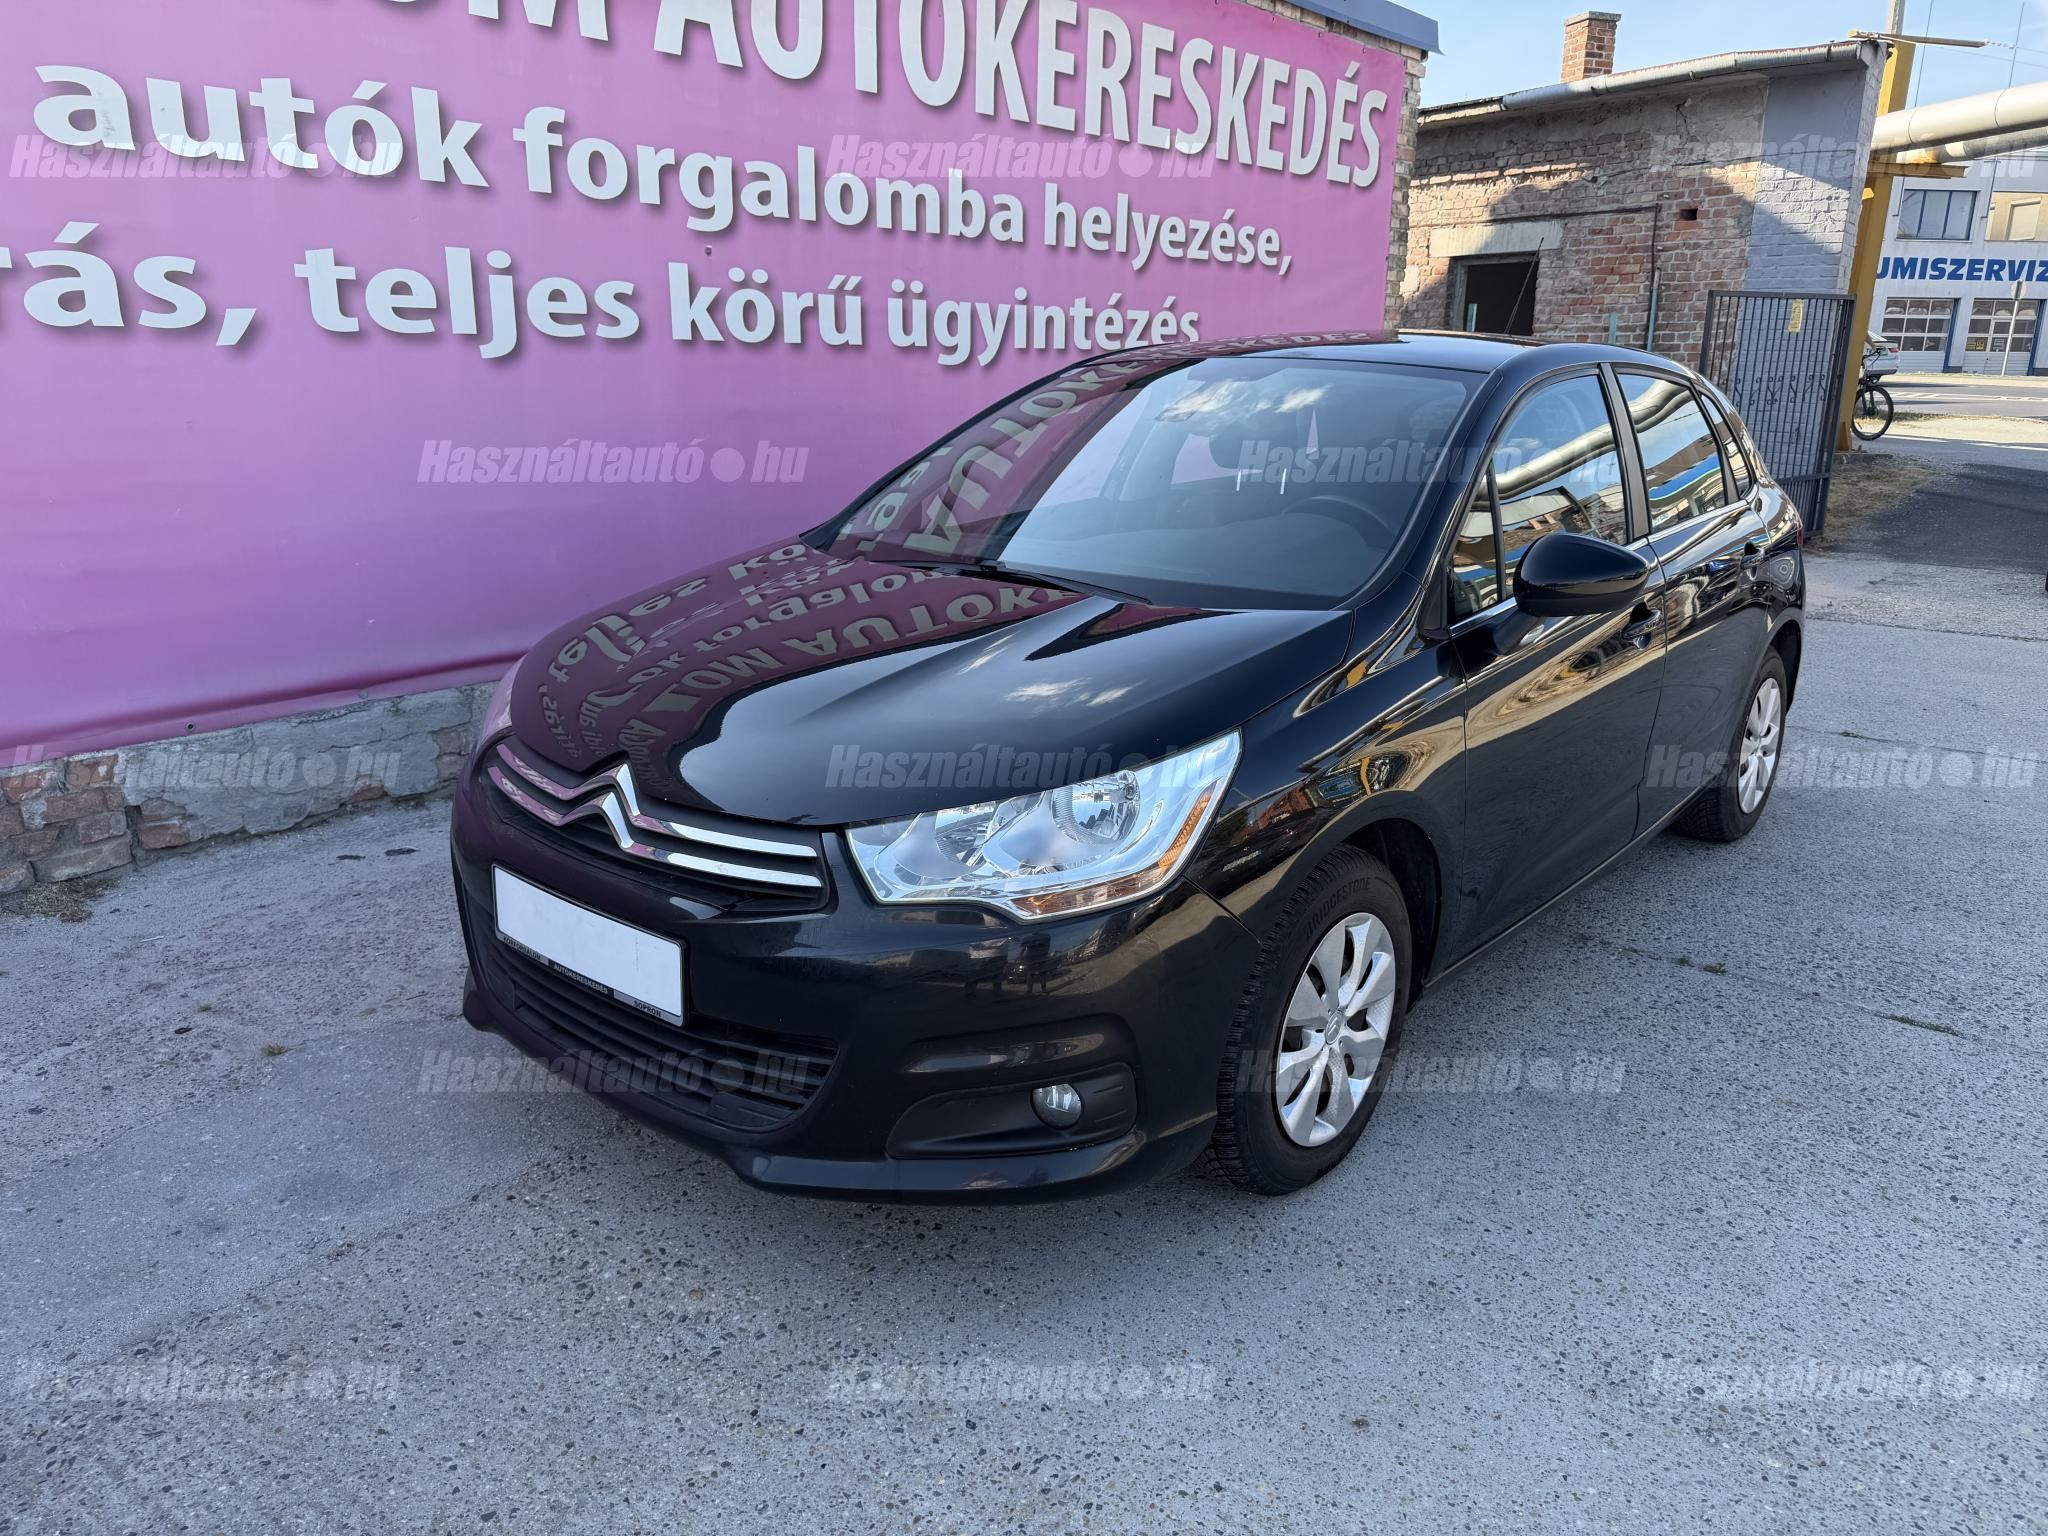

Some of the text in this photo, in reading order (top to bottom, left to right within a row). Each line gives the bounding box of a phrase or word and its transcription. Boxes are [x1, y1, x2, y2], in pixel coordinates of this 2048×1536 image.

[33, 64, 1293, 275] autók forgalomba helyezése,
[294, 246, 640, 358] teljes
[668, 261, 863, 347] körű
[887, 280, 1199, 368] ügyintézés
[633, 1000, 662, 1018] SOPRON
